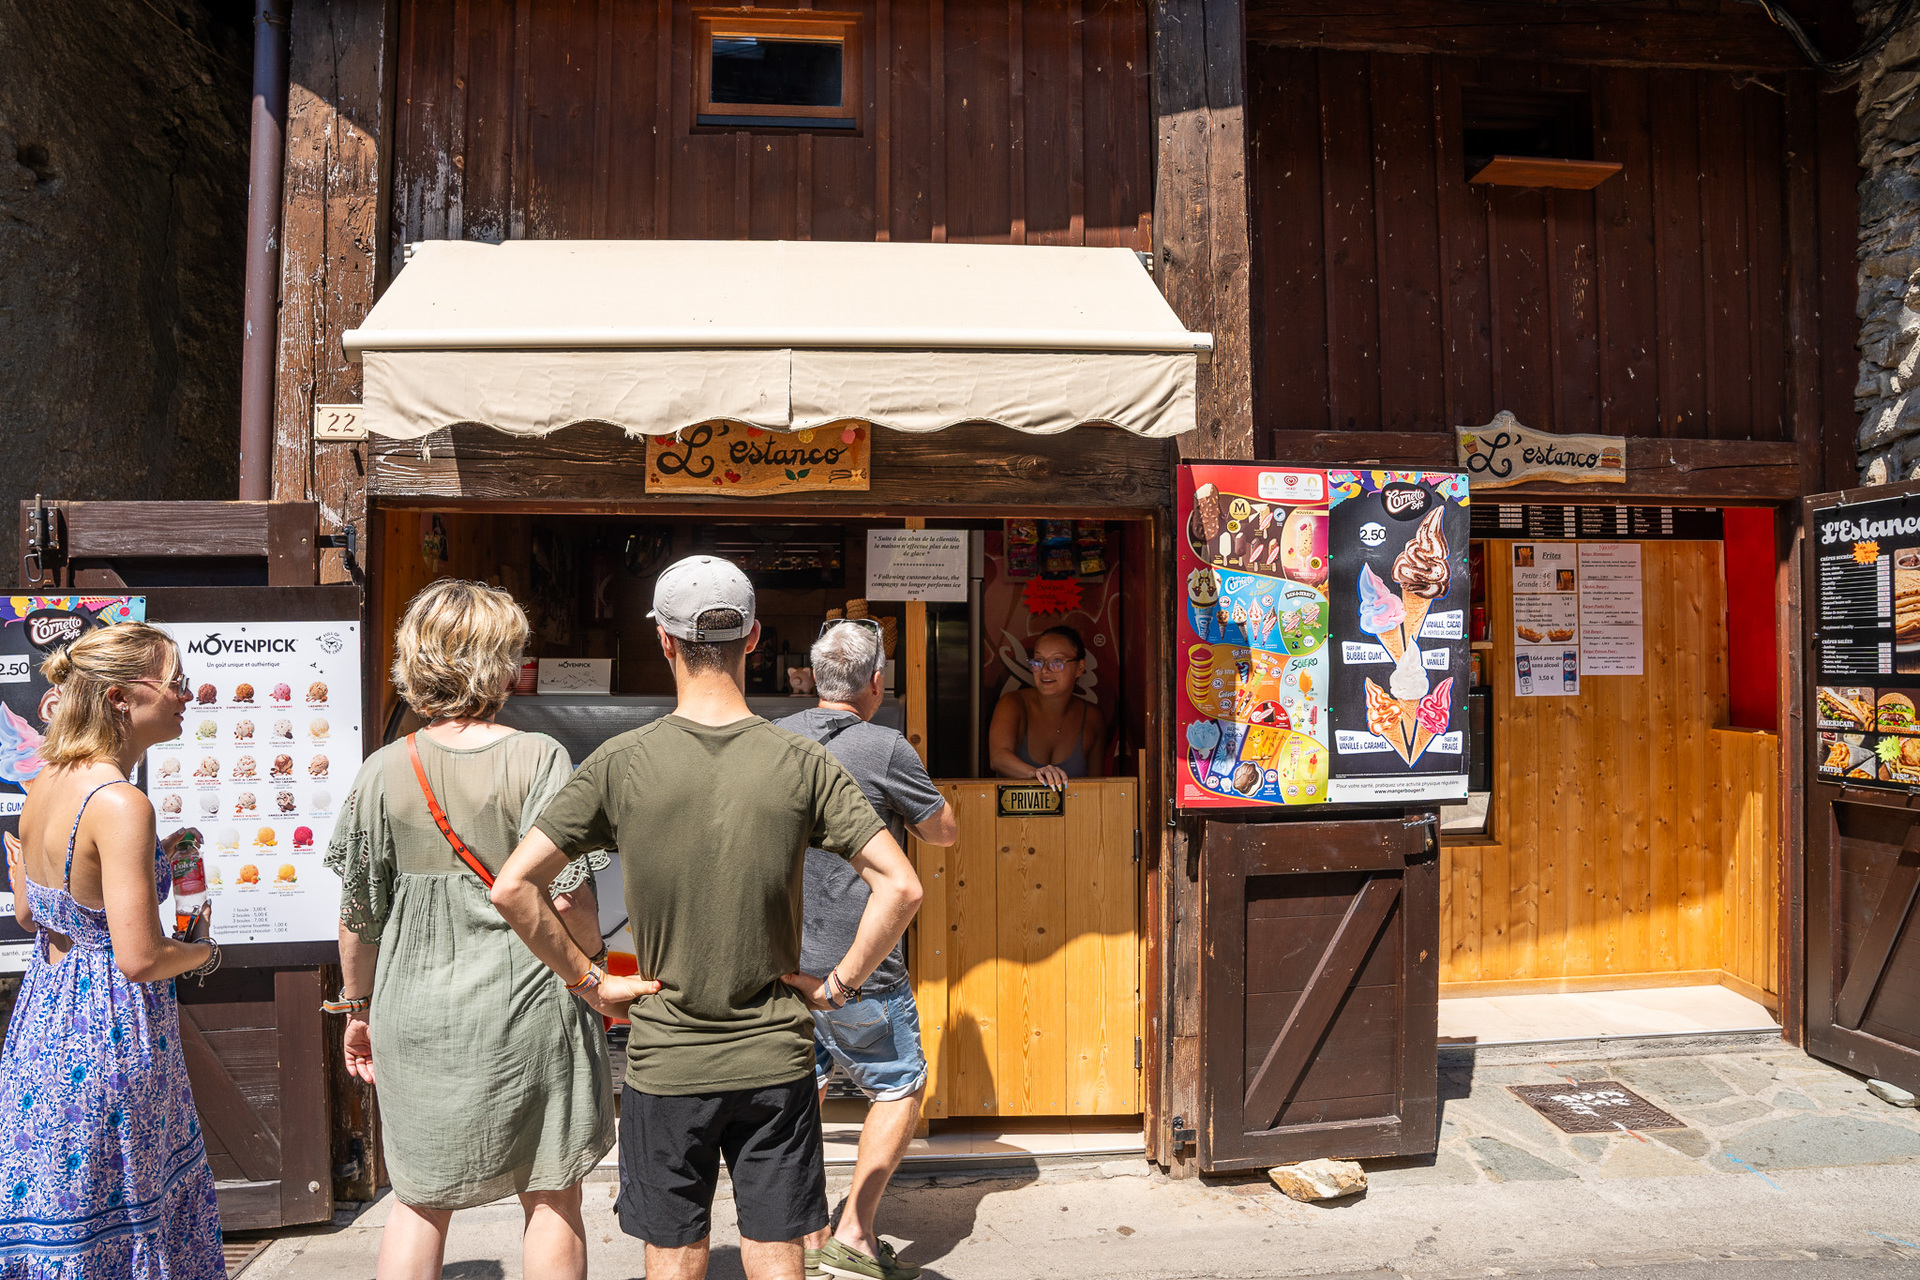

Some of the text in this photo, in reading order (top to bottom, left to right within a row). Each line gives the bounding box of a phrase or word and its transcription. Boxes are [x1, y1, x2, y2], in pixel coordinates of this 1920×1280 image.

[328, 413, 356, 432] 22
[656, 419, 848, 478] L'estanco
[1467, 432, 1600, 478] L'estanco
[1385, 489, 1425, 514] Cornetto
[1410, 502, 1424, 510] Soft
[1360, 529, 1386, 540] 2.50
[1821, 517, 1920, 544] L'Estanc
[1542, 552, 1562, 560] Frites
[30, 616, 82, 645] Cornetto
[62, 628, 81, 640] Soft
[1346, 652, 1366, 660] BUBBLE
[1291, 658, 1318, 671] SOLERO
[1364, 740, 1387, 749] CARAMEL
[1011, 792, 1050, 809] PRIVATE
